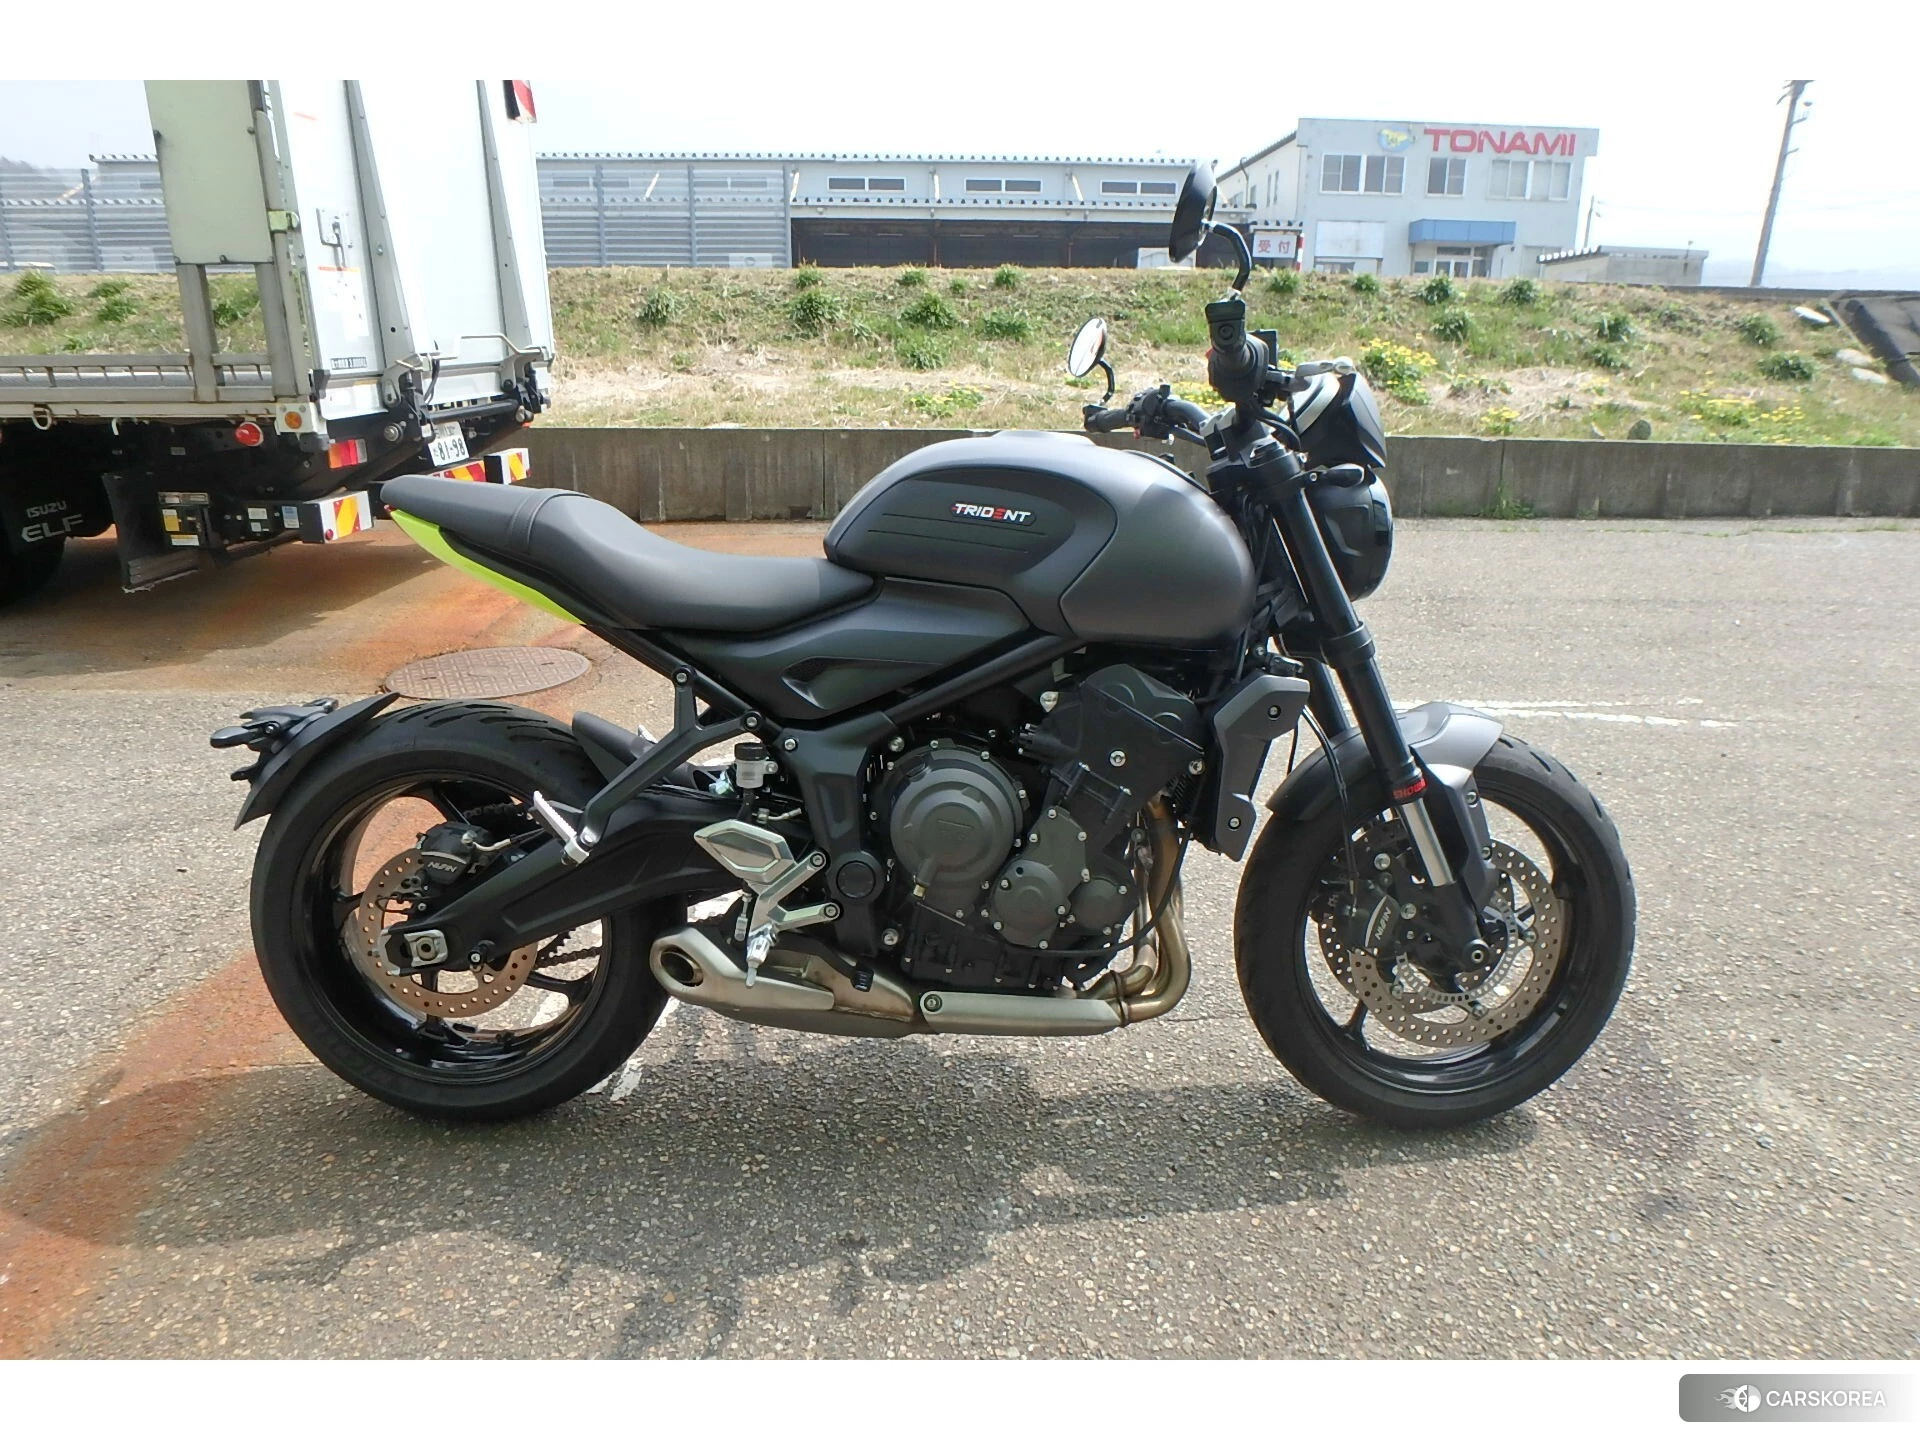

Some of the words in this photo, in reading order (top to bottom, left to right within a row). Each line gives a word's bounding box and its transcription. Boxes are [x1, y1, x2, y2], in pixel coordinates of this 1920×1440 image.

[1423, 128, 1577, 157] TONAMI
[1257, 239, 1291, 254] 受付
[26, 501, 67, 518] ISUZU
[955, 503, 1032, 523] TRIDENT
[21, 513, 84, 543] ELF
